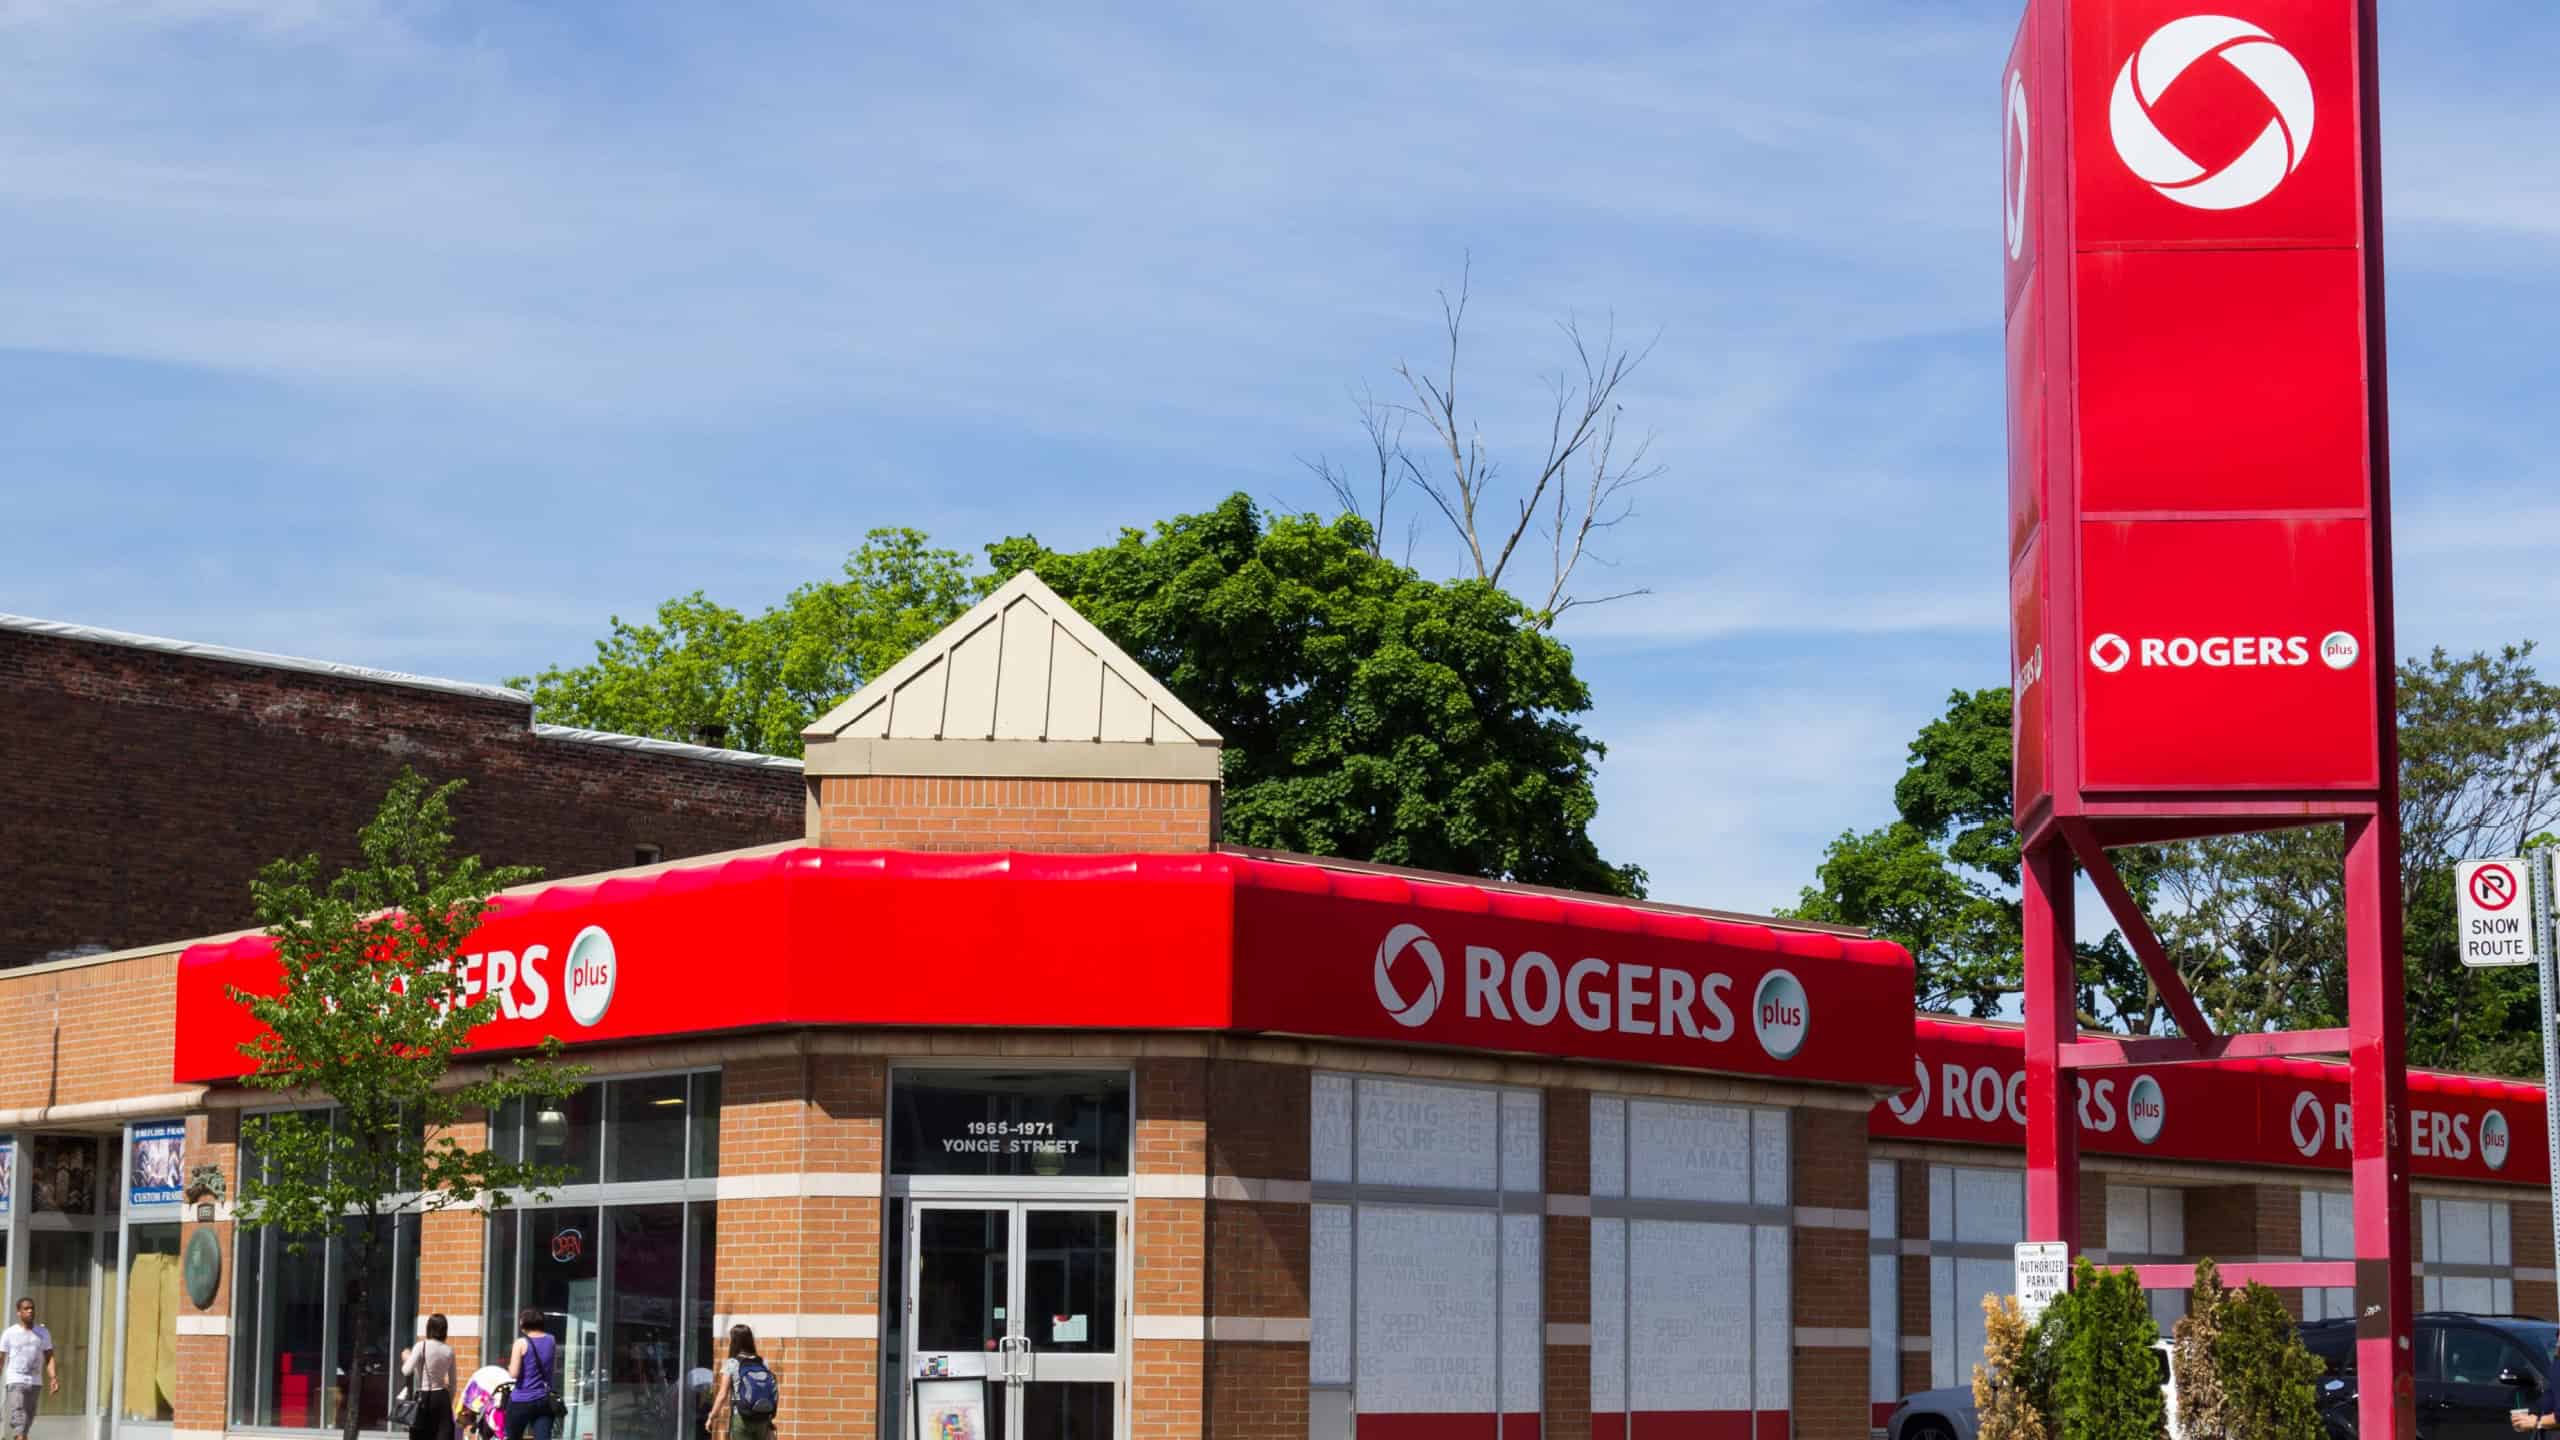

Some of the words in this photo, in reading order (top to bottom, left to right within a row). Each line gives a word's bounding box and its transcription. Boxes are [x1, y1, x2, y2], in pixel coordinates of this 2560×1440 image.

[2141, 636, 2309, 667] ROGERS
[2327, 644, 2353, 658] plus
[2472, 918, 2519, 935] SNOW
[2468, 939, 2524, 956] ROUTE
[573, 959, 607, 994] plus
[1465, 945, 1736, 1043] ROGERS
[1763, 998, 1801, 1029] plus
[1942, 1063, 2117, 1133] ROGRS
[2134, 1097, 2160, 1121] plus
[2334, 1103, 2471, 1160] RERS
[2485, 1129, 2505, 1147] plus
[942, 1139, 1000, 1153] YONGE
[1009, 1139, 1080, 1153] STREET
[2020, 1260, 2064, 1273] AUTHORIZED
[2026, 1275, 2059, 1288] PARKING
